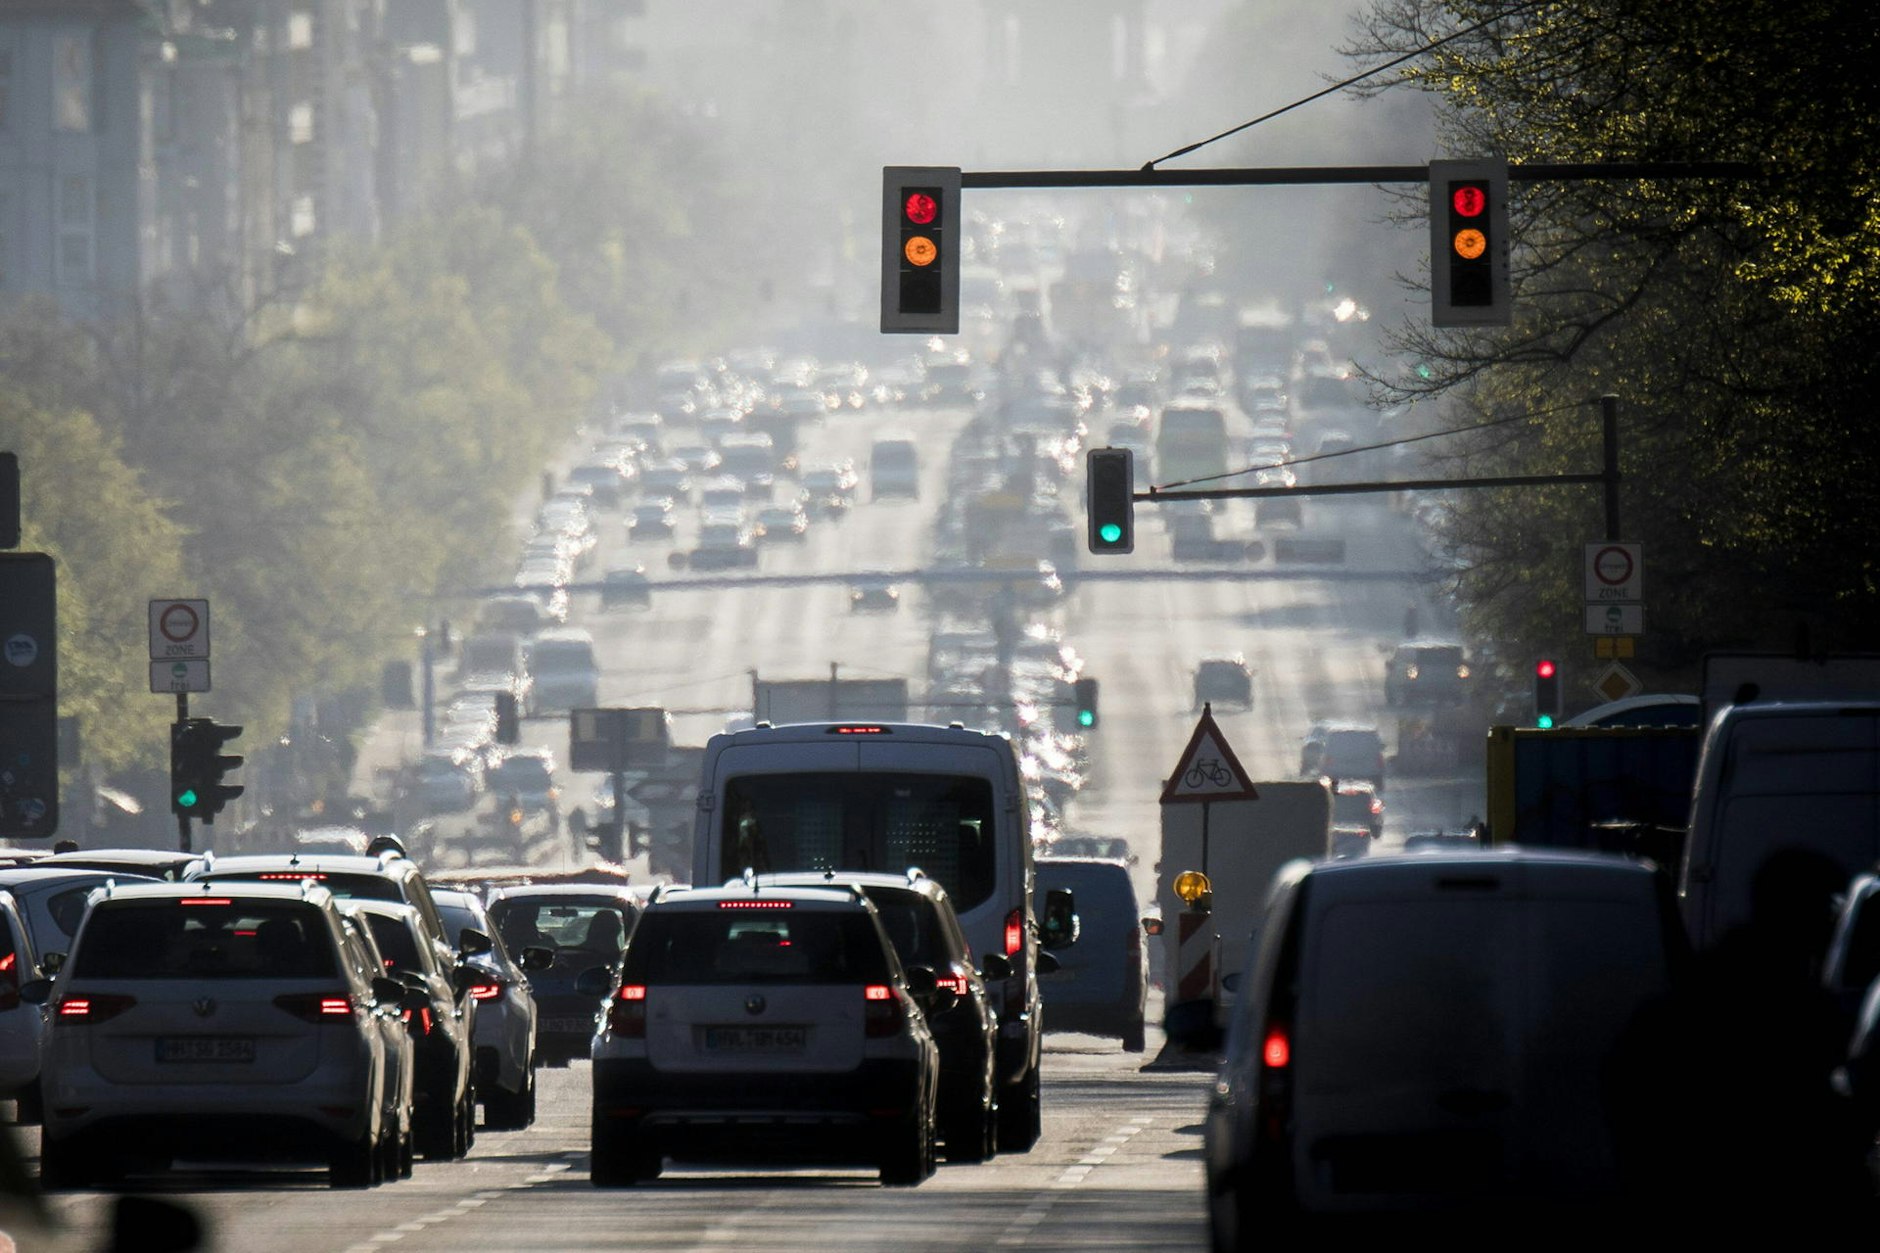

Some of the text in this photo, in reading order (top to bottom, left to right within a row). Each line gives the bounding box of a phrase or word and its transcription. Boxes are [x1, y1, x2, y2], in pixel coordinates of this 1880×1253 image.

[1599, 587, 1628, 599] ZONE
[1604, 623, 1624, 633] frei
[166, 645, 195, 656] ZONE
